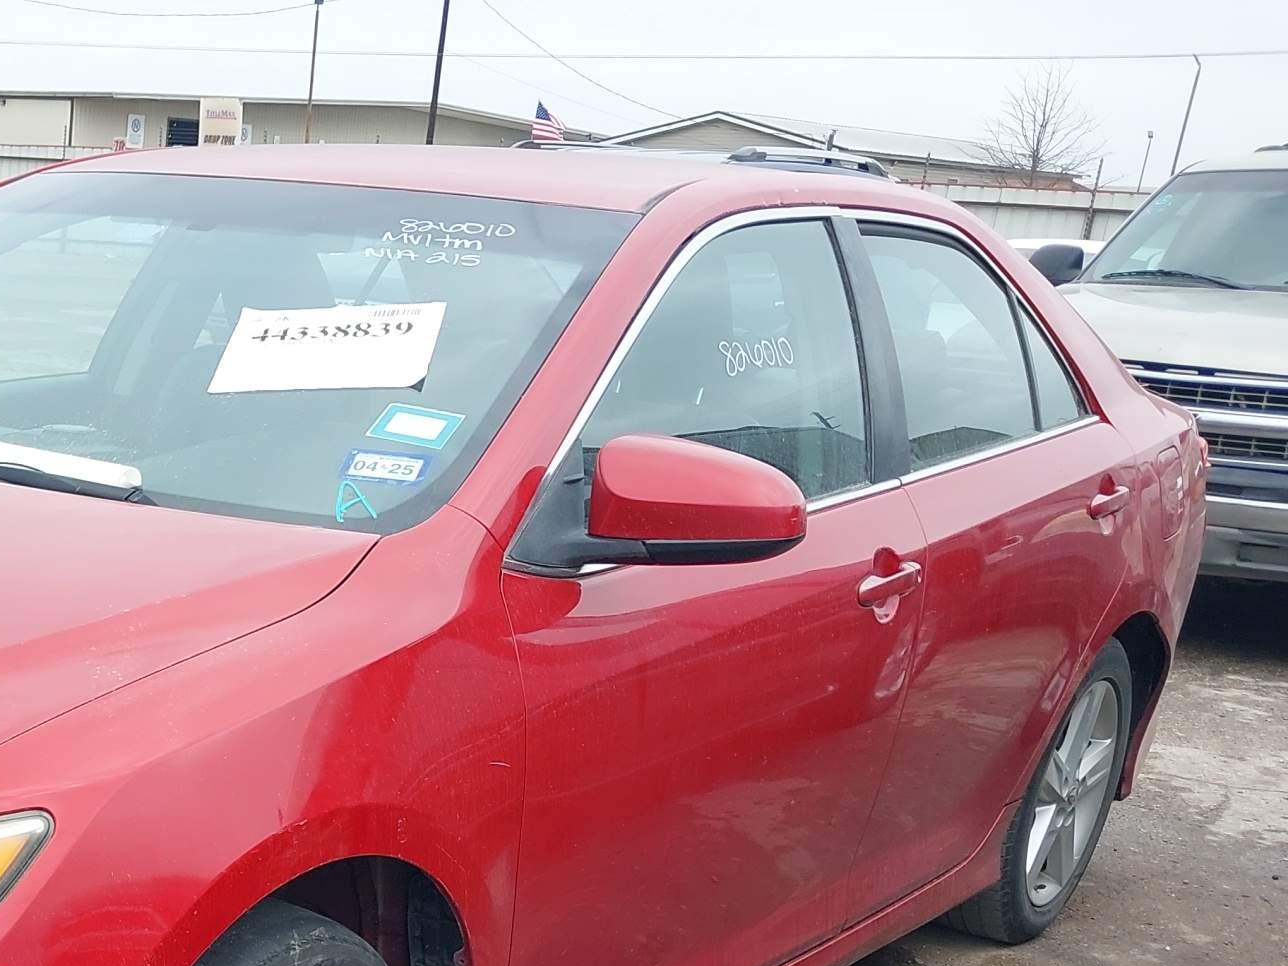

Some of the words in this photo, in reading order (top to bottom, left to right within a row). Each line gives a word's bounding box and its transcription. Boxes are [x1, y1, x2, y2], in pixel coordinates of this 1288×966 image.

[251, 321, 414, 342] 44338839
[718, 337, 794, 376] 826010
[336, 480, 378, 522] A
